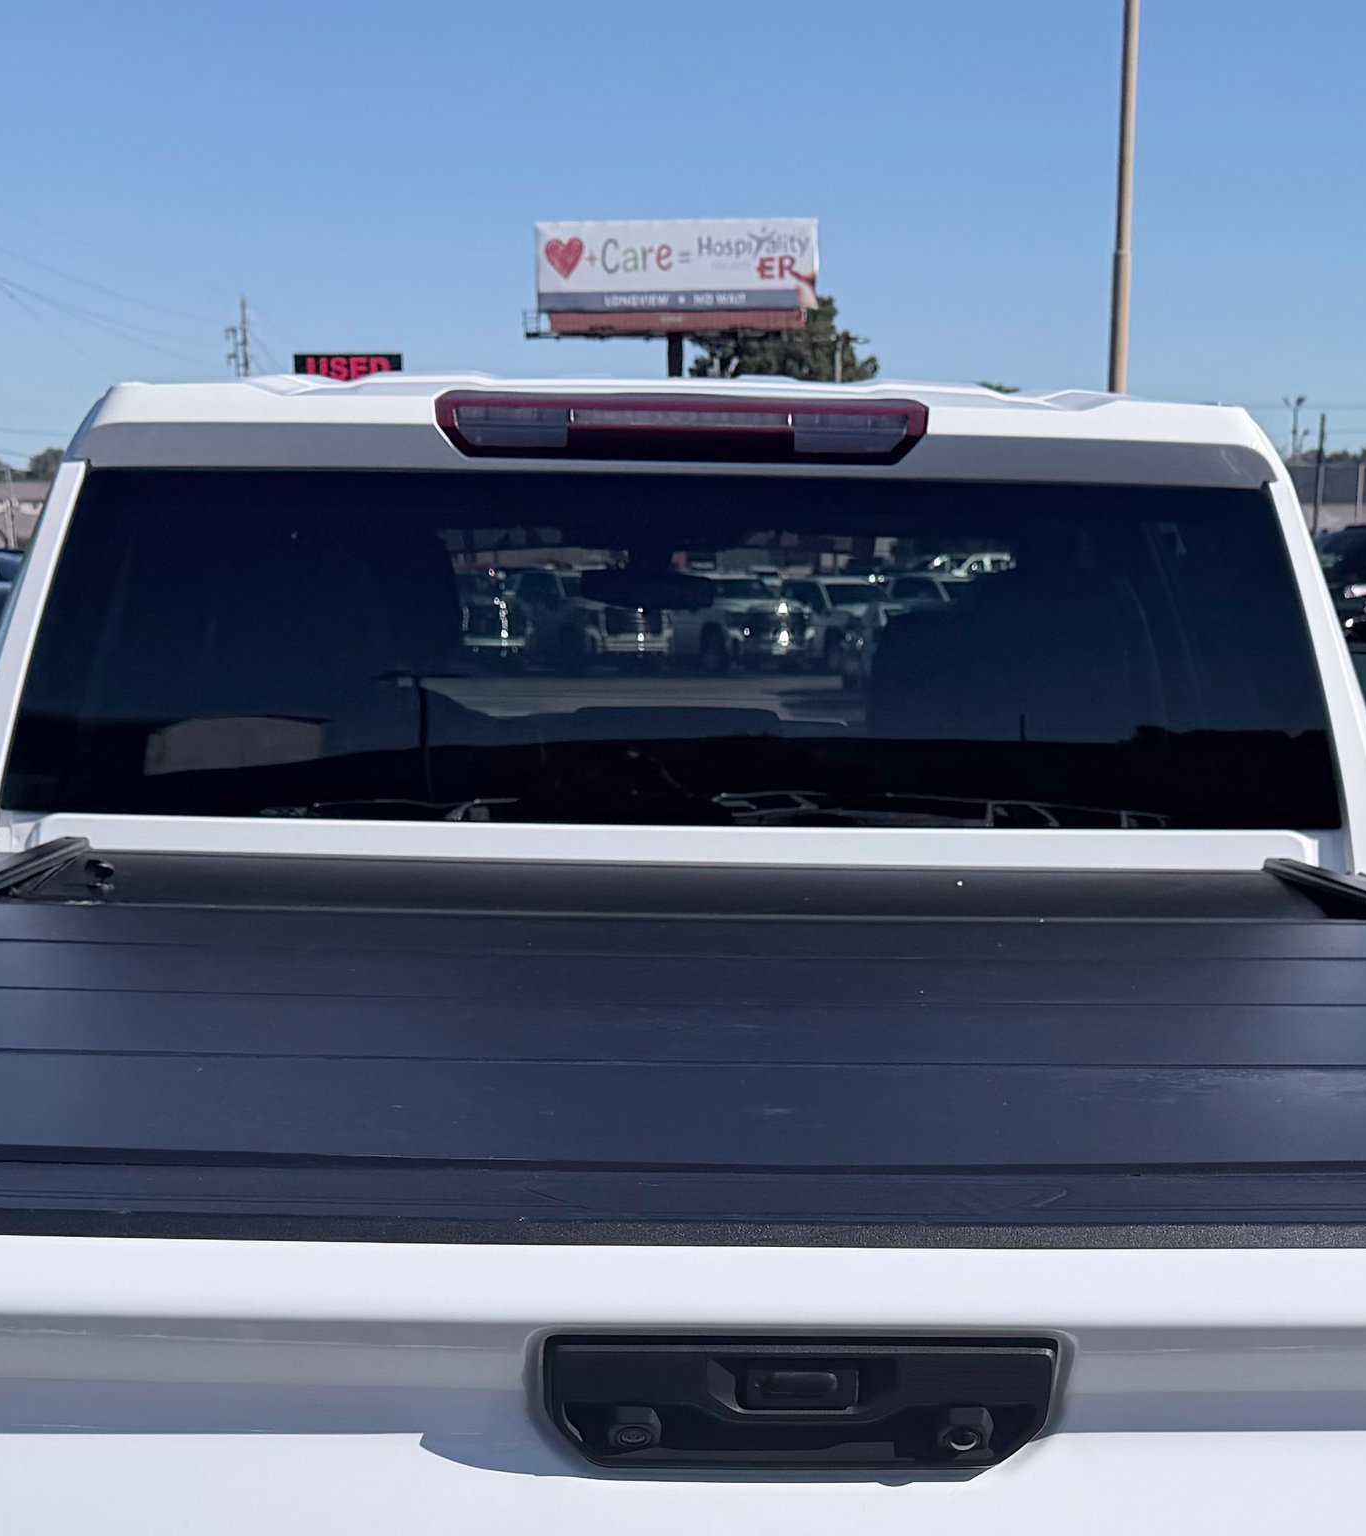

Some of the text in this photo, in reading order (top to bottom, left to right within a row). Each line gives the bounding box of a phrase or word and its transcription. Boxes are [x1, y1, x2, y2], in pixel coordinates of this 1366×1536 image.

[601, 237, 673, 275] Care
[758, 254, 803, 281] ER
[306, 357, 391, 381] USED
